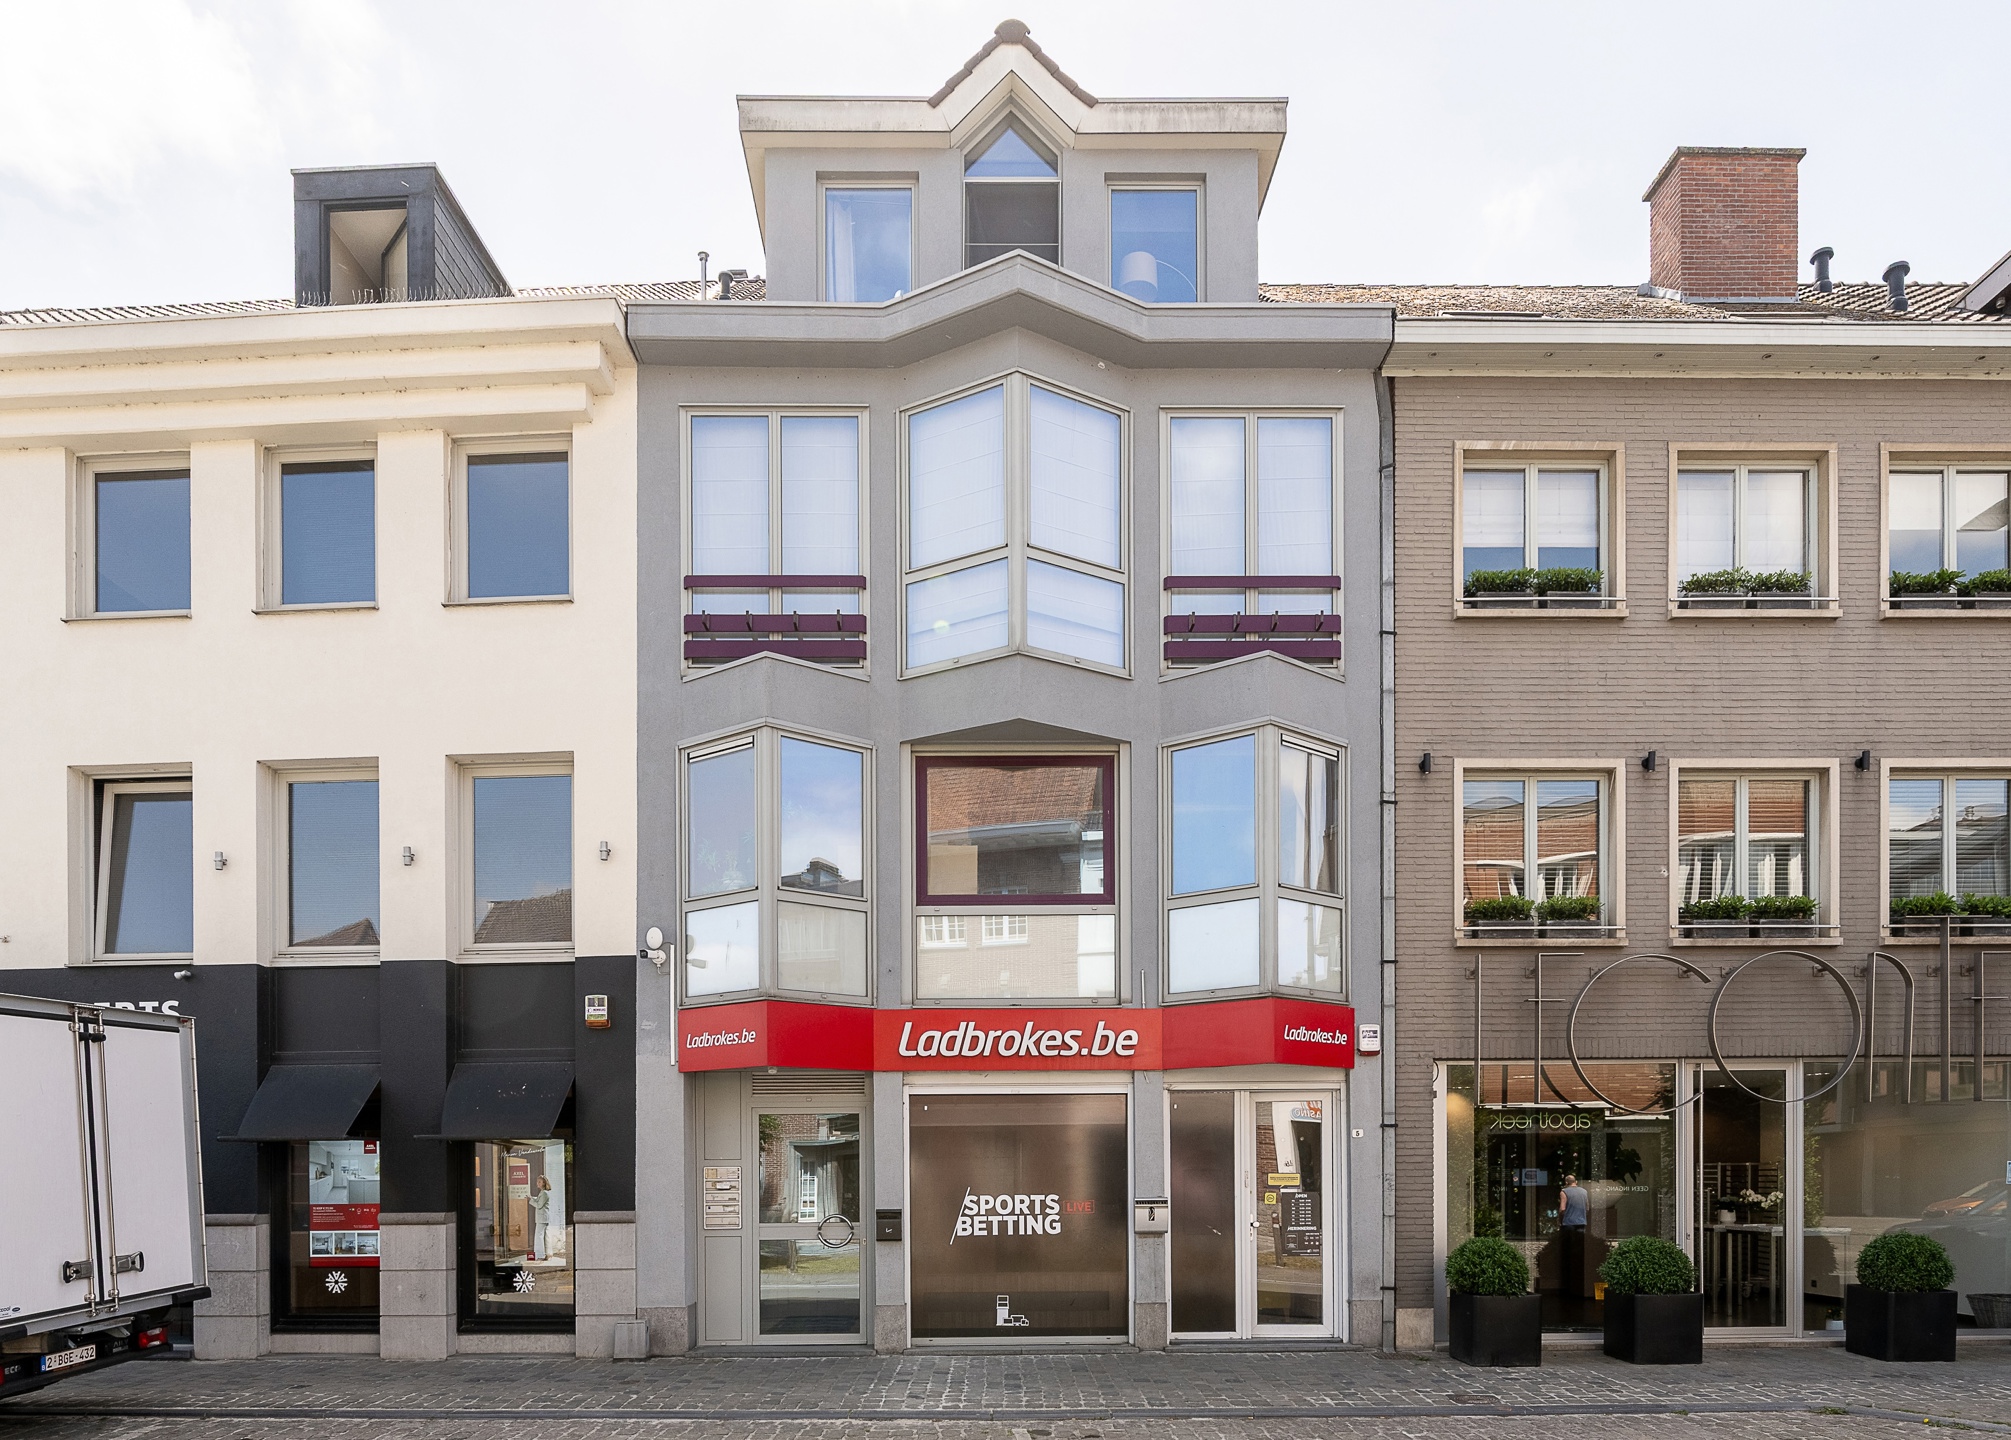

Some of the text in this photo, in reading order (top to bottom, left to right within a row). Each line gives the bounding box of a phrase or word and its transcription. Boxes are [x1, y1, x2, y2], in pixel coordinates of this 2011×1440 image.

[686, 1028, 756, 1048] Ladbrokes.be
[898, 1021, 1139, 1057] Ladbrokes.be
[1284, 1024, 1348, 1045] Ladbrokes.be
[963, 1194, 1092, 1215] SPORTS LIVE
[956, 1214, 1061, 1236] BETTING
